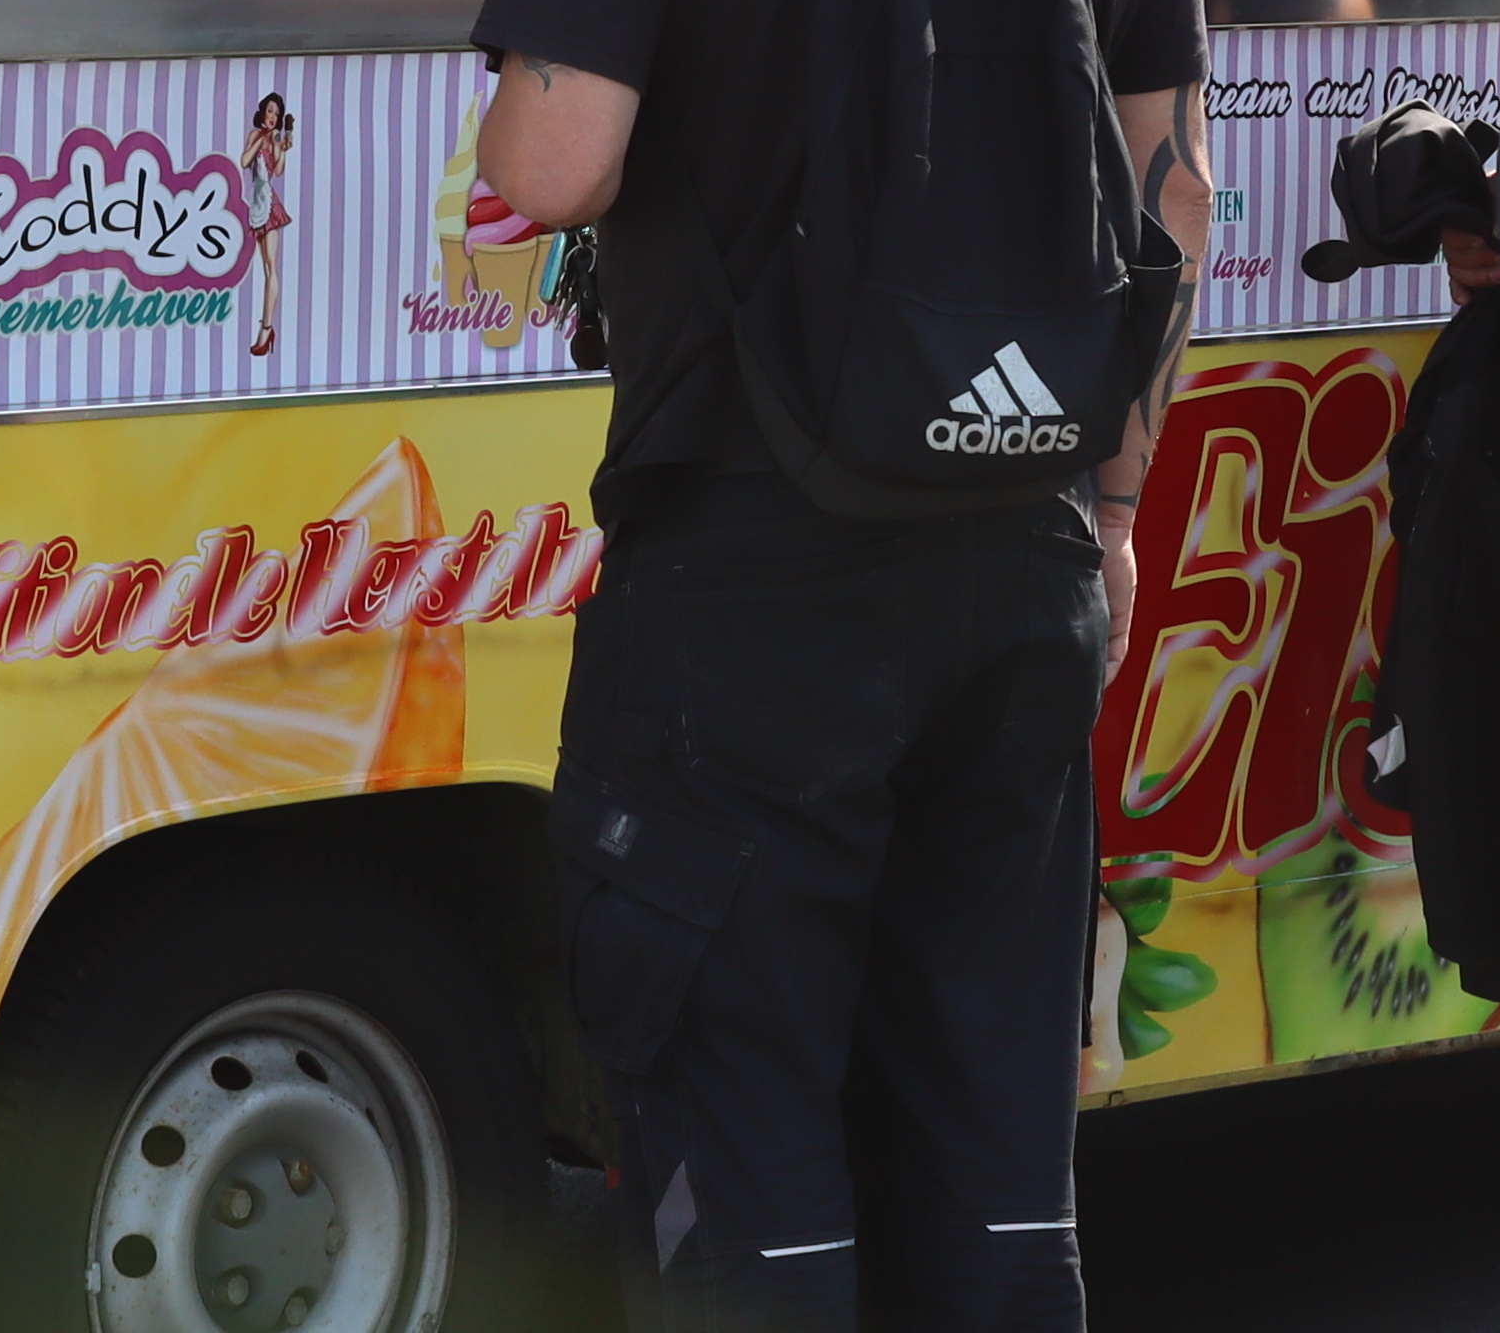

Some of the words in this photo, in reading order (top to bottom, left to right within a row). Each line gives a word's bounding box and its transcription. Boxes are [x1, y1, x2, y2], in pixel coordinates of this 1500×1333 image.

[1305, 67, 1375, 119] and
[1211, 249, 1273, 291] large
[402, 289, 513, 335] Vanille
[925, 414, 1082, 455] adidas
